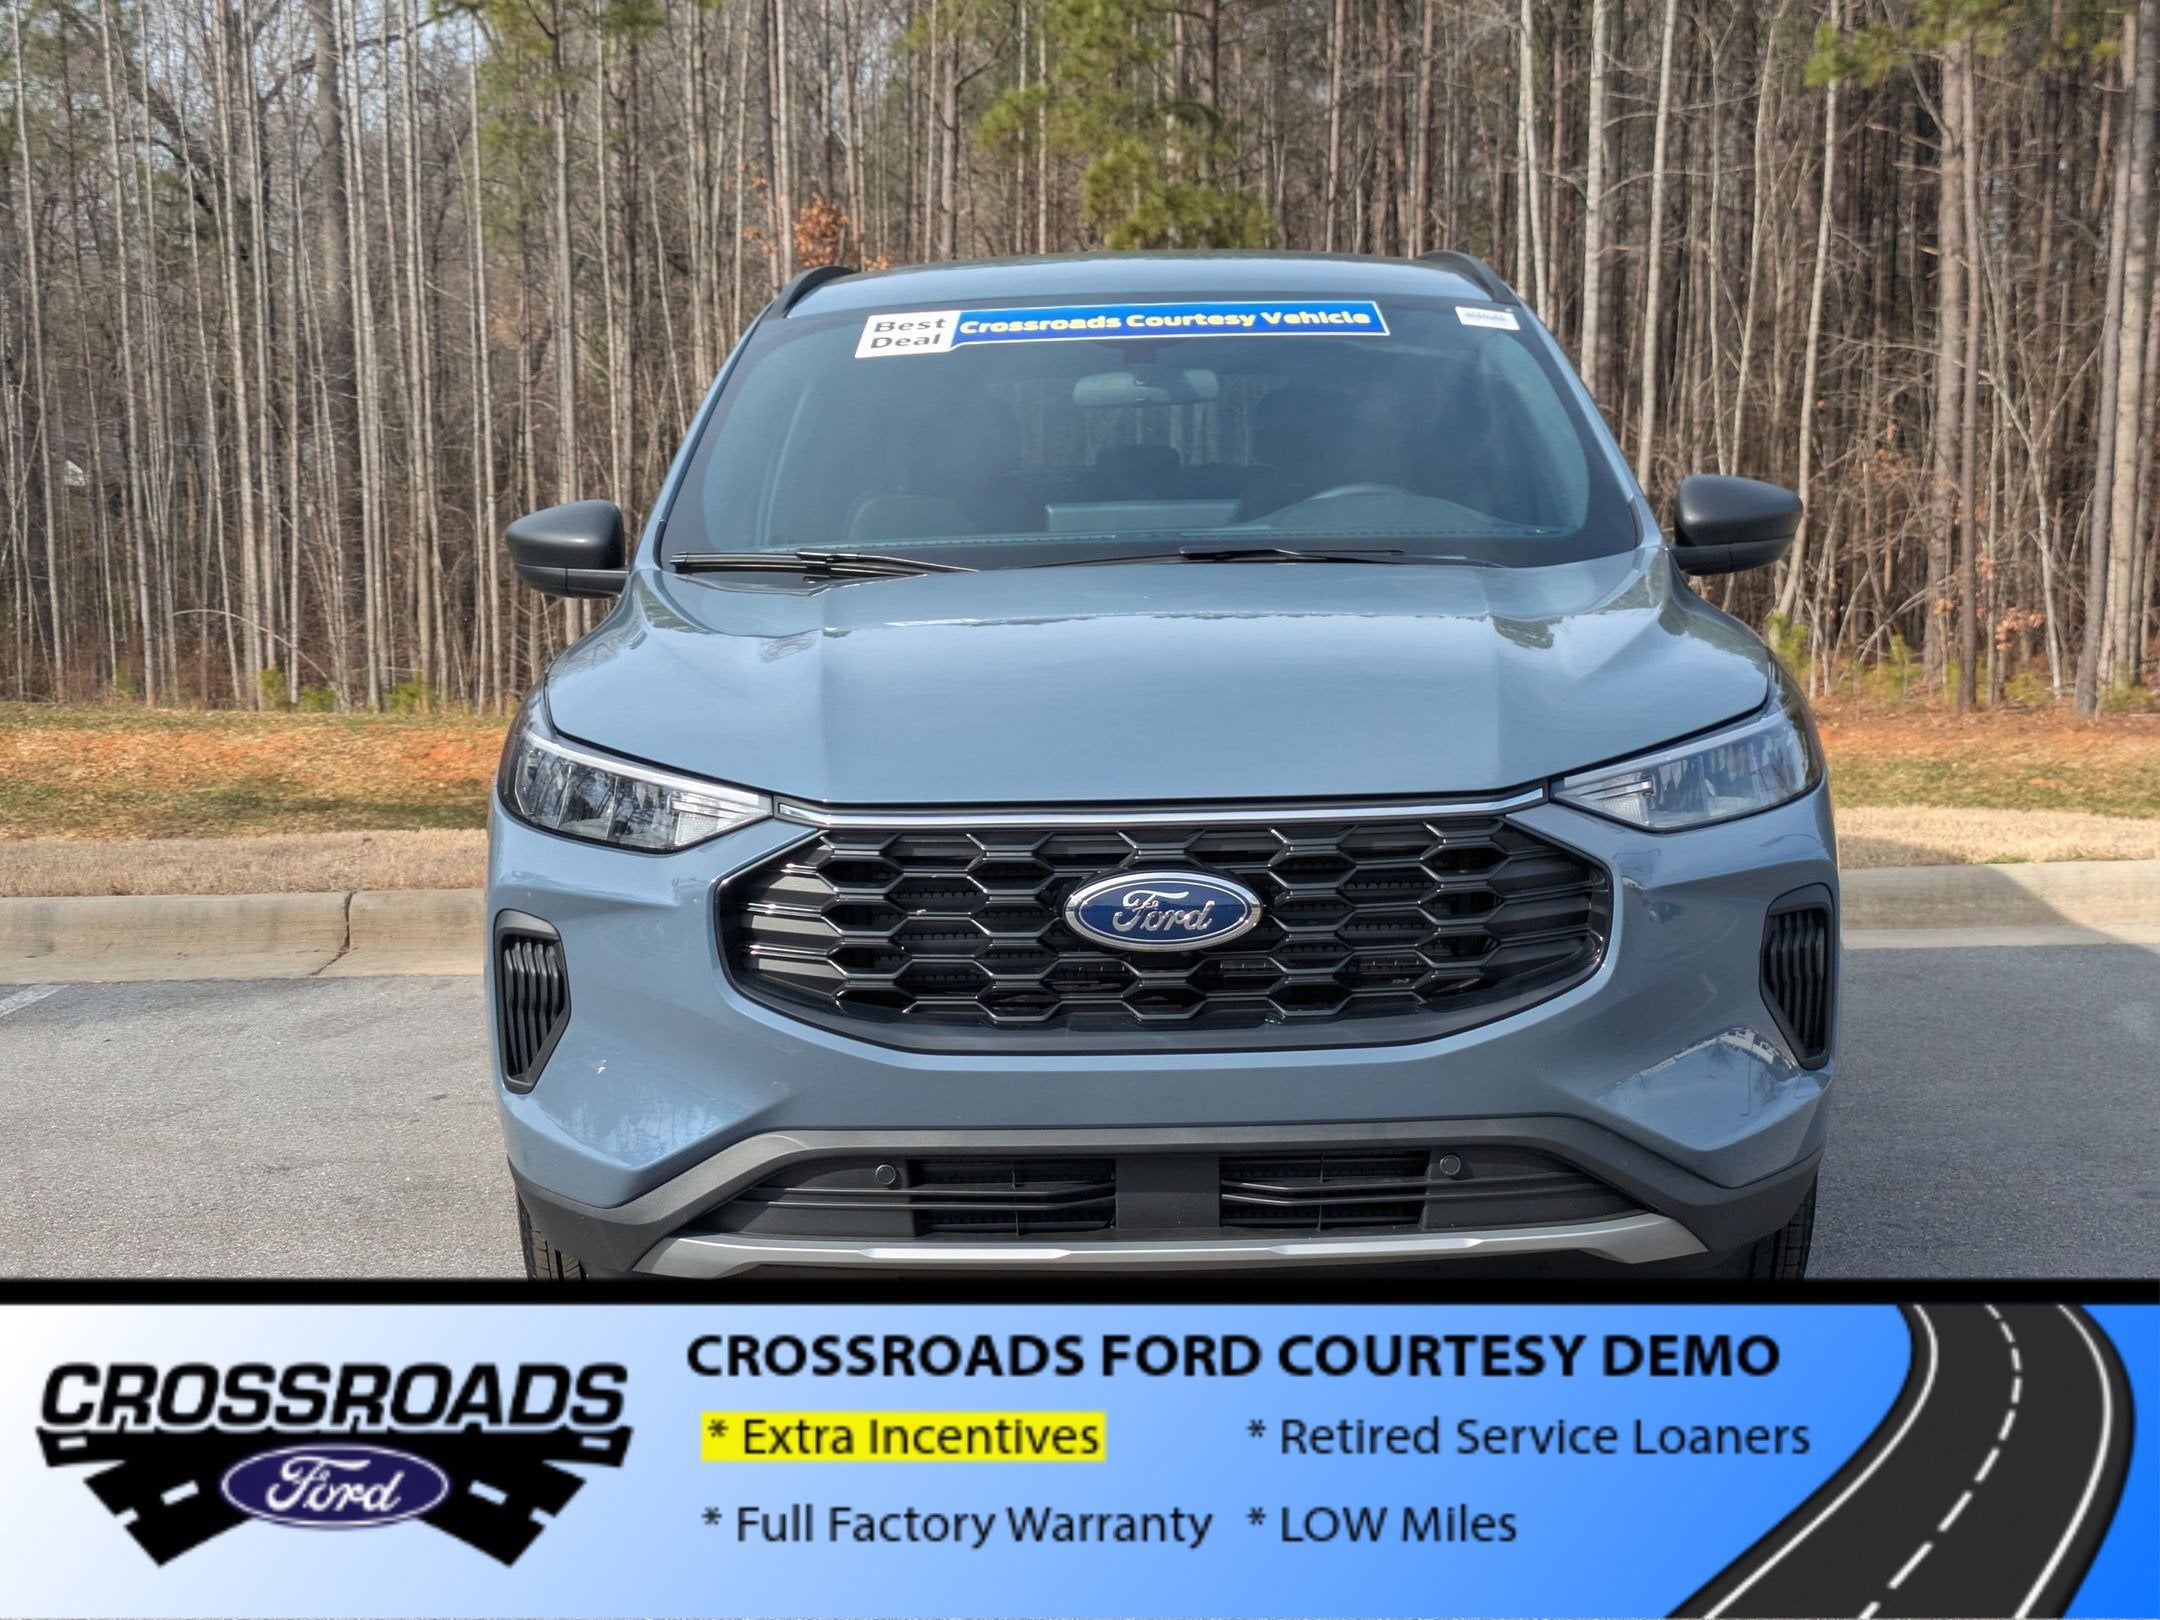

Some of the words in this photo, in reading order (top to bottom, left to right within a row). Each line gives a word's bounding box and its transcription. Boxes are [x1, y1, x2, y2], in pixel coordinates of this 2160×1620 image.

[873, 317, 947, 333] Best
[959, 315, 1122, 335] Crossroads
[1126, 312, 1256, 328] Courtesy
[1260, 310, 1372, 325] Vehicle
[870, 333, 942, 349] Deal
[1112, 889, 1215, 932] Ford
